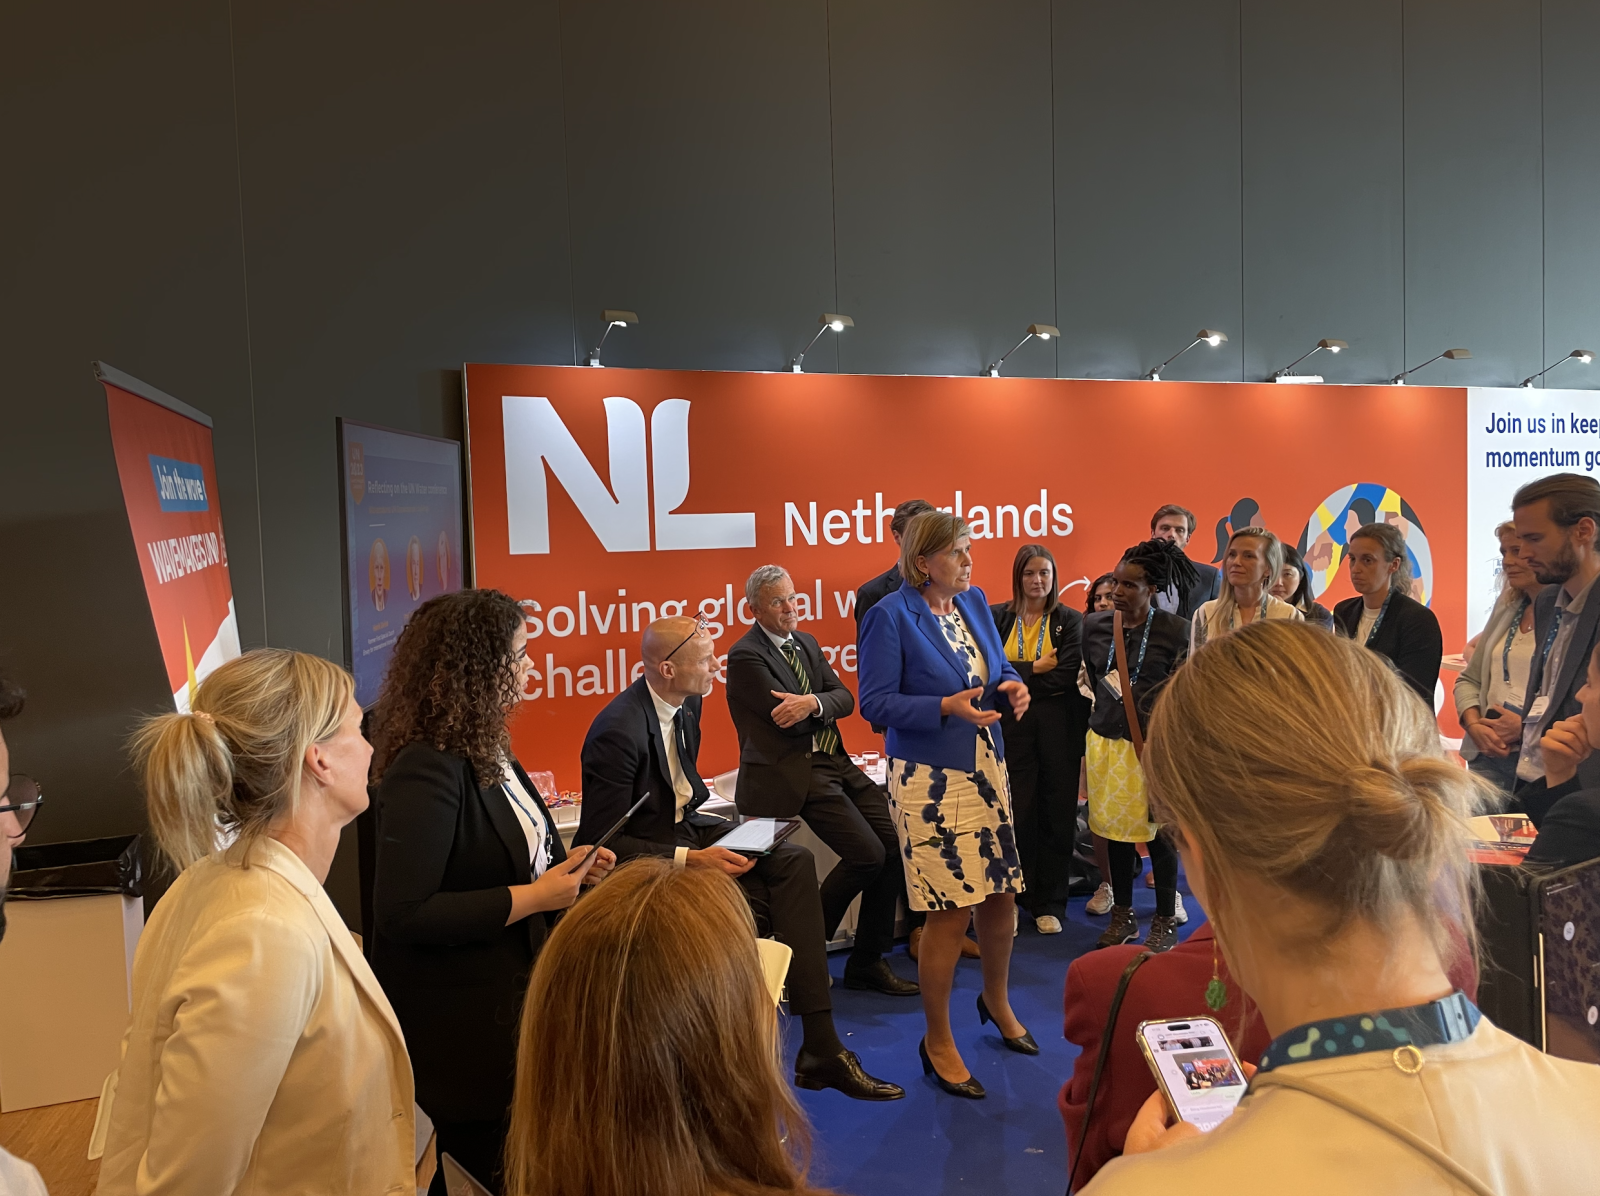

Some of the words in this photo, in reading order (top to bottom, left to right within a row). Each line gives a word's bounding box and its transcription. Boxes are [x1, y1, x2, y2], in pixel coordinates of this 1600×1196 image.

[1485, 412, 1522, 434] Join
[1527, 418, 1546, 434] us
[1551, 412, 1566, 434] in
[1570, 412, 1600, 439] kee
[502, 396, 756, 555] NL
[1486, 447, 1580, 468] momentum
[156, 464, 178, 500] Join
[172, 467, 188, 500] the
[367, 480, 394, 497] Reflecting
[393, 486, 401, 494] on
[400, 482, 408, 494] the
[784, 488, 1074, 547] Nethlands
[698, 578, 823, 640] gloal
